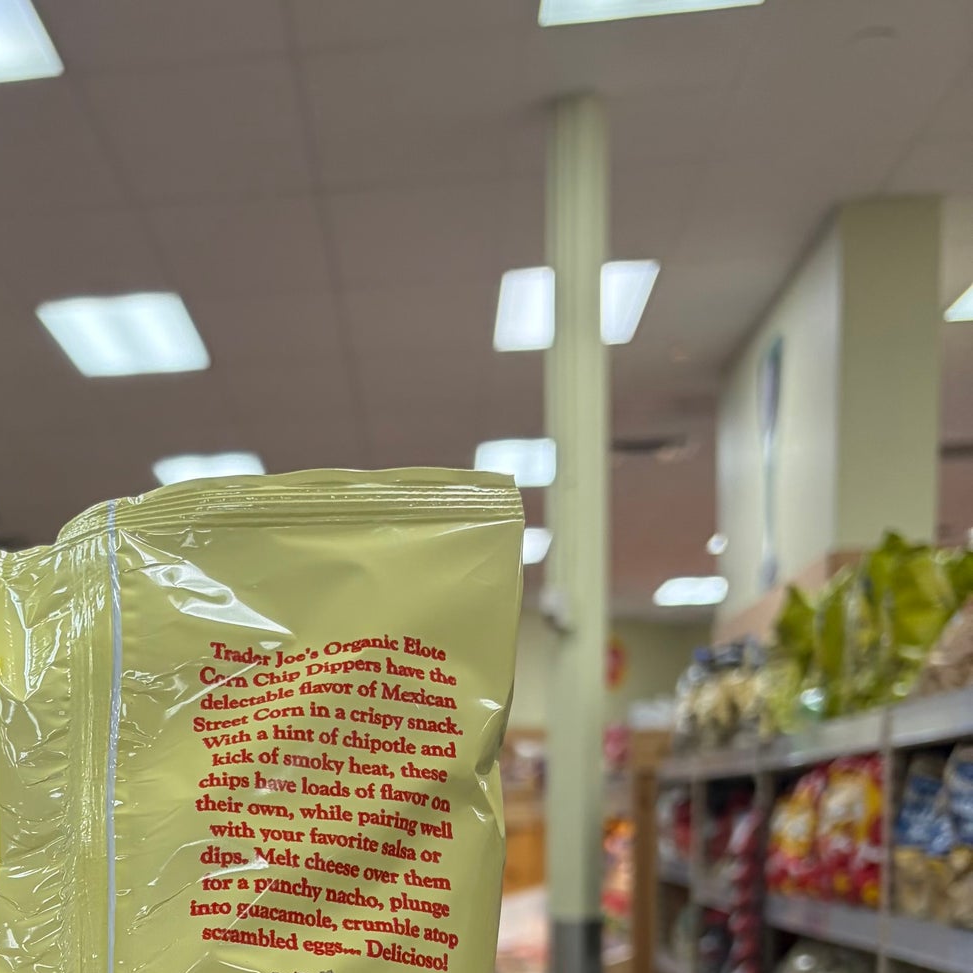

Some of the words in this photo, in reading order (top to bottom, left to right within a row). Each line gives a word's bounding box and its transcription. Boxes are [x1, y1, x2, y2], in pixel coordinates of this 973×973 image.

[210, 642, 271, 667] Trader
[275, 647, 319, 668] Joe's
[323, 634, 398, 656] Organic
[403, 635, 447, 661] Elote
[253, 670, 301, 688] Chip
[306, 659, 382, 677] Dippers
[386, 657, 425, 680] have
[429, 667, 457, 686] the
[200, 688, 294, 710] delectable
[298, 681, 353, 696] flavor
[381, 682, 457, 710] Mexican
[193, 715, 249, 733] Street
[253, 705, 305, 722] Corn
[309, 702, 331, 718] in
[350, 706, 404, 730] crispy
[407, 716, 463, 736] snack.
[202, 730, 252, 750] With
[273, 725, 314, 743] hint
[342, 730, 416, 755] chipotle
[421, 742, 457, 759] and
[212, 751, 254, 767] kick
[283, 753, 345, 775] smoky
[348, 757, 395, 779] heat,
[400, 762, 448, 782] these
[198, 772, 250, 790] chips
[301, 777, 351, 798] loads
[380, 785, 429, 807] flavor
[195, 794, 243, 813] their
[247, 802, 295, 821] own,
[299, 803, 353, 822] while
[357, 809, 418, 837] pairing
[420, 822, 454, 840] well
[209, 821, 256, 839] with
[259, 827, 305, 843] your
[309, 827, 379, 852] favorite
[381, 839, 417, 861] salsa
[304, 852, 360, 879] cheese
[362, 867, 399, 884] over
[403, 869, 451, 891] them
[326, 886, 384, 911] nacho,
[389, 892, 450, 918] plunge
[190, 900, 232, 917] into
[236, 901, 338, 932] guacamole,
[342, 917, 420, 939] crumble
[423, 927, 459, 949] atop
[202, 925, 299, 951] scrambled
[365, 939, 449, 971] Delicioso!
